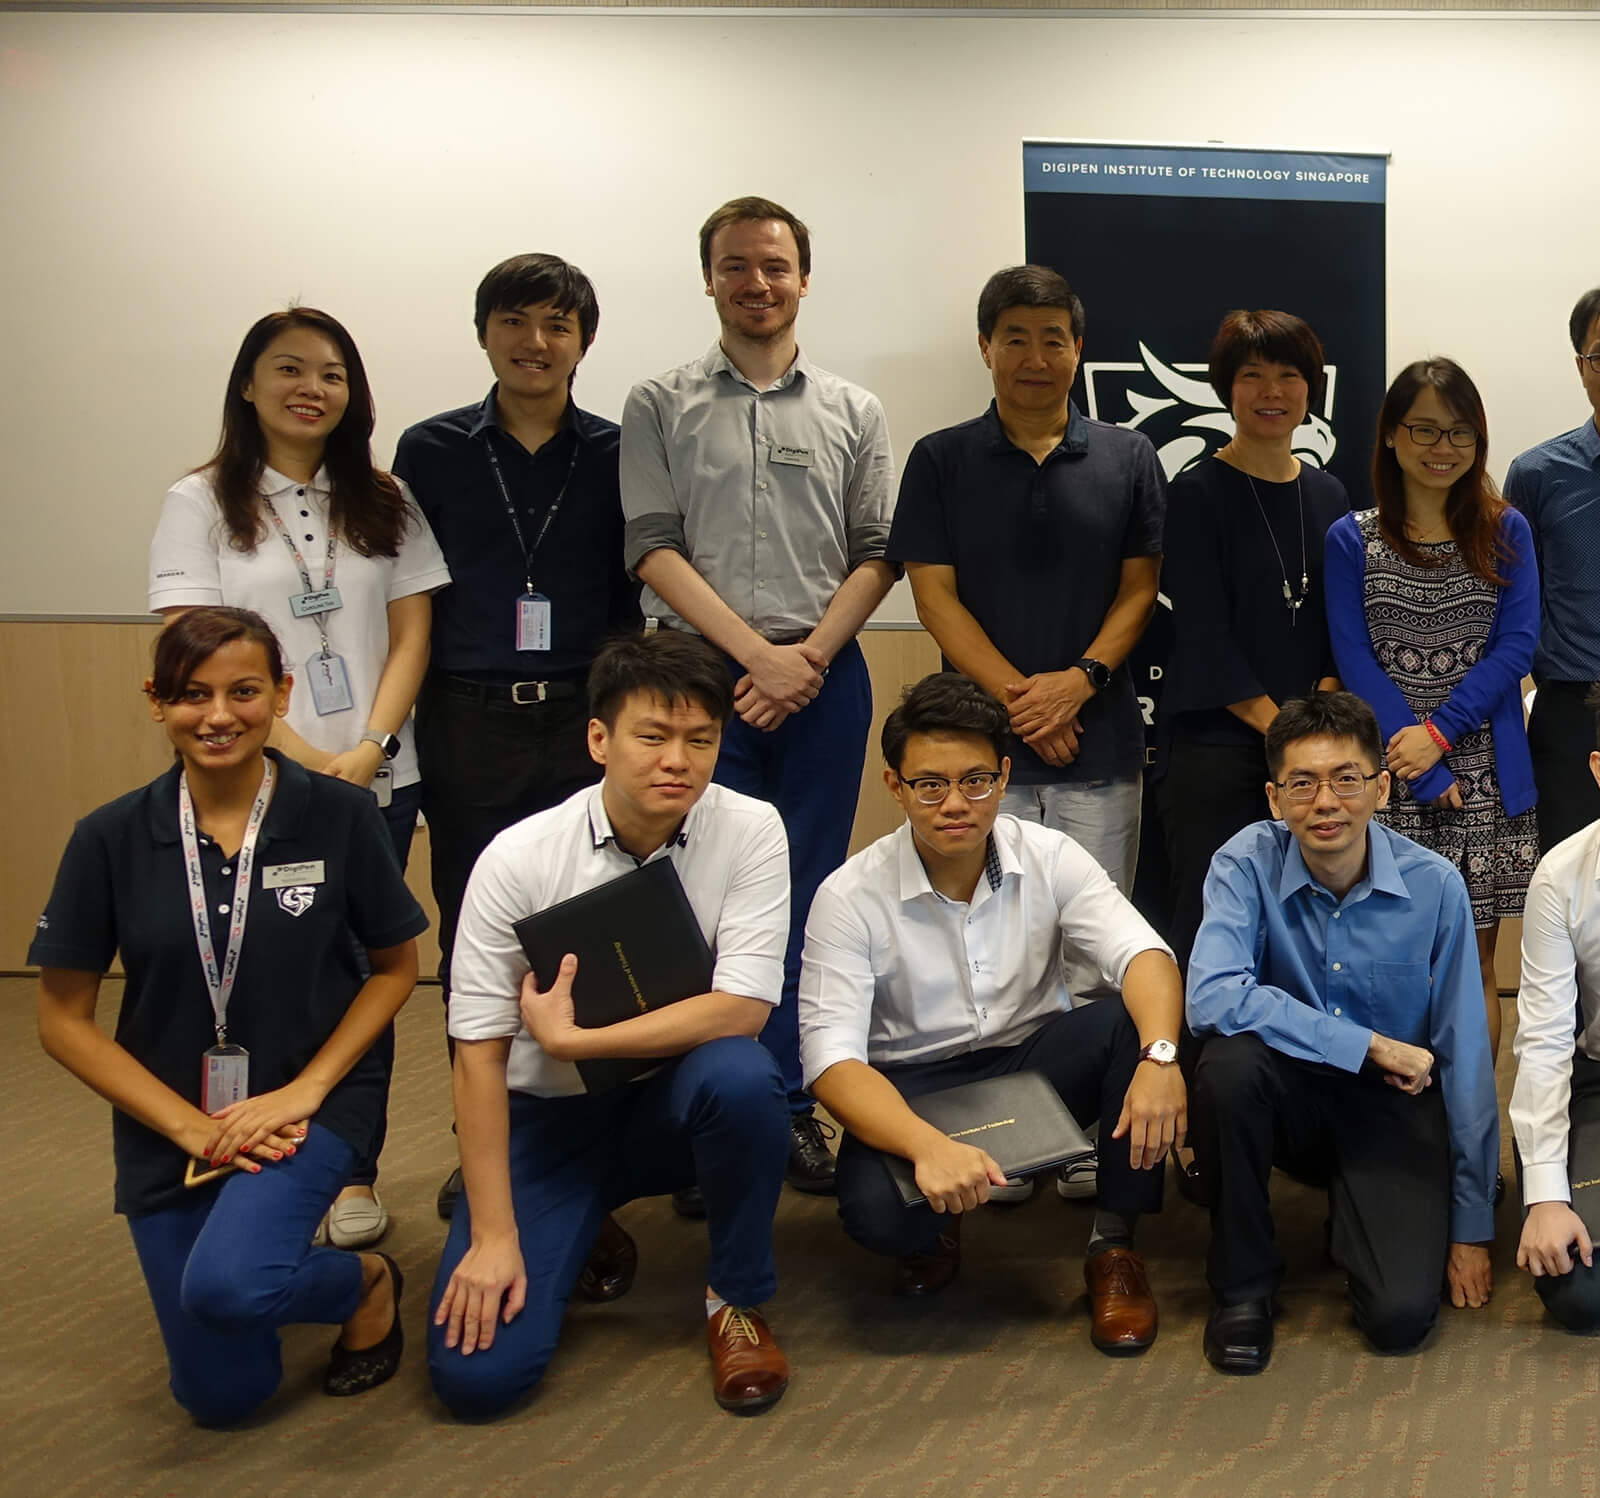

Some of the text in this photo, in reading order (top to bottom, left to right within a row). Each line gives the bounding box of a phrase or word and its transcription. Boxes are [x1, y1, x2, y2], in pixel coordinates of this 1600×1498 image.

[1042, 162, 1369, 184] DIGIPEN INSTITUTE OF TECHNOLOGY SINGAPORE
